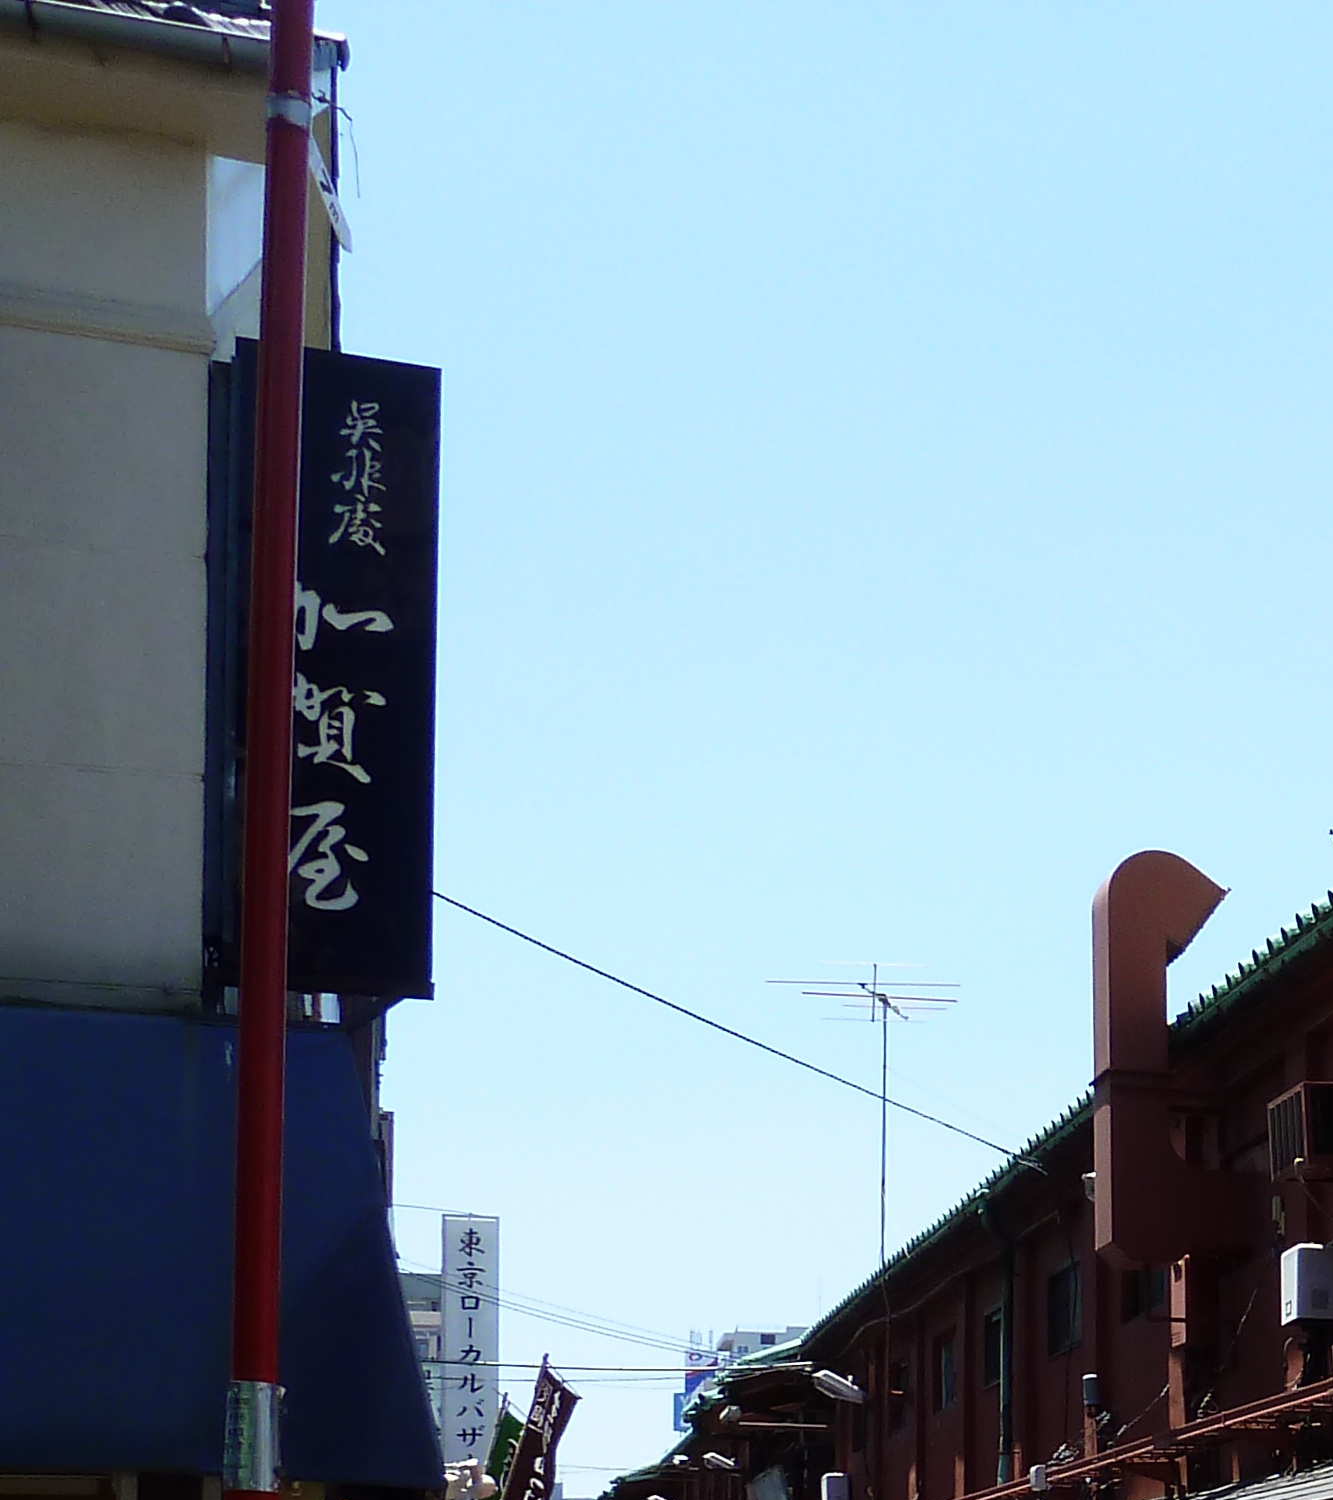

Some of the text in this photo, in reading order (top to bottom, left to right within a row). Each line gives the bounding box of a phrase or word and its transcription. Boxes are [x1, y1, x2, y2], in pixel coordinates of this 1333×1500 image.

[455, 1227, 487, 1461] 東京ローカルバザ
